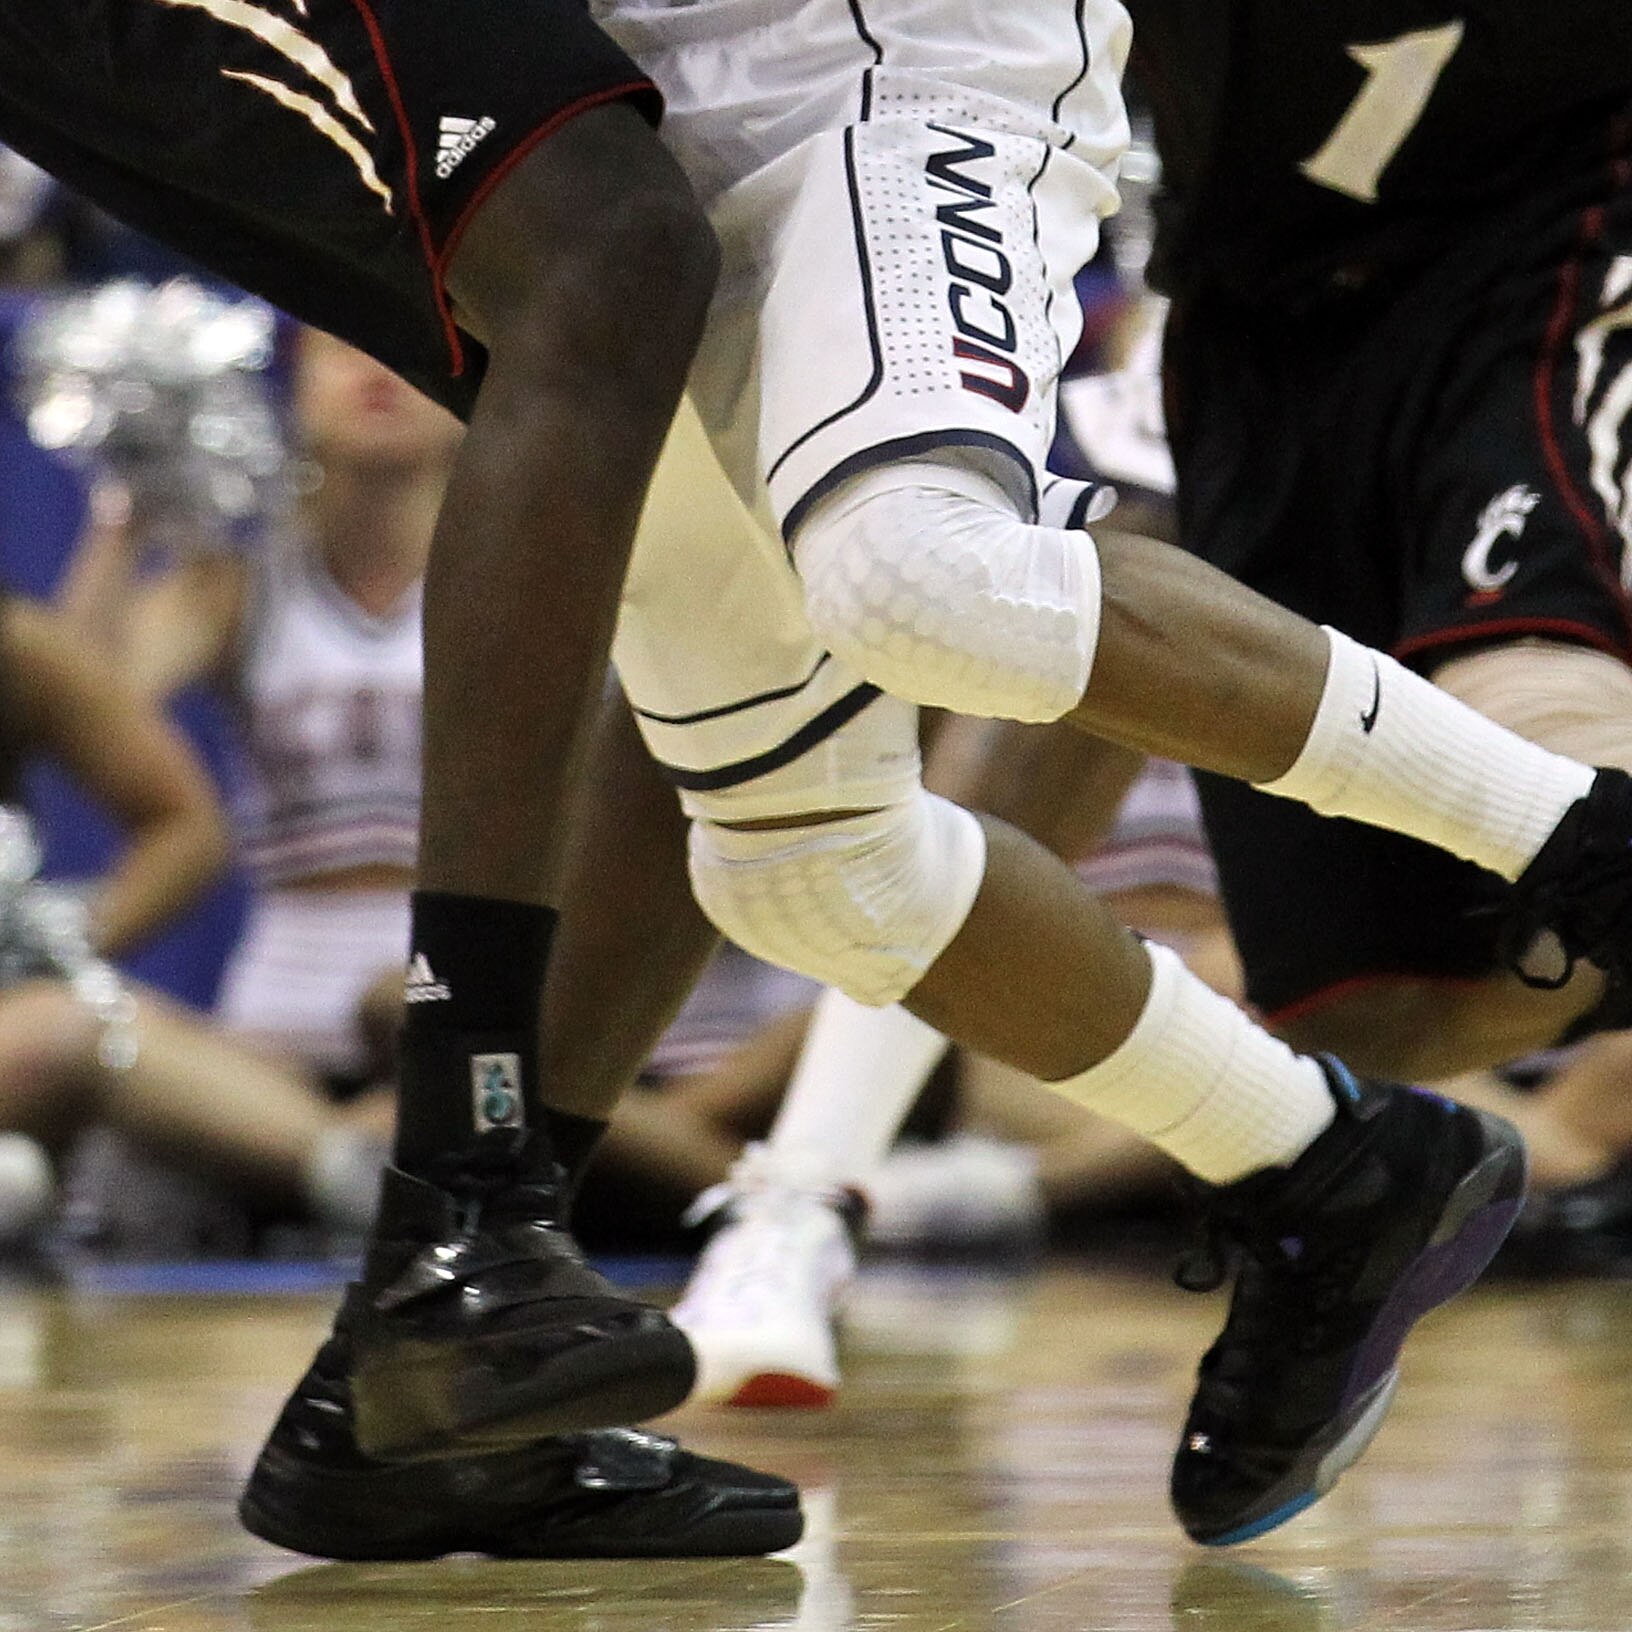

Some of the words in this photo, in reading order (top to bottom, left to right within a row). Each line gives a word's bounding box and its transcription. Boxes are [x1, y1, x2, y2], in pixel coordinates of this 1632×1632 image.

[435, 117, 496, 179] adidas
[1299, 18, 1467, 204] 1
[924, 121, 1030, 413] UCONN
